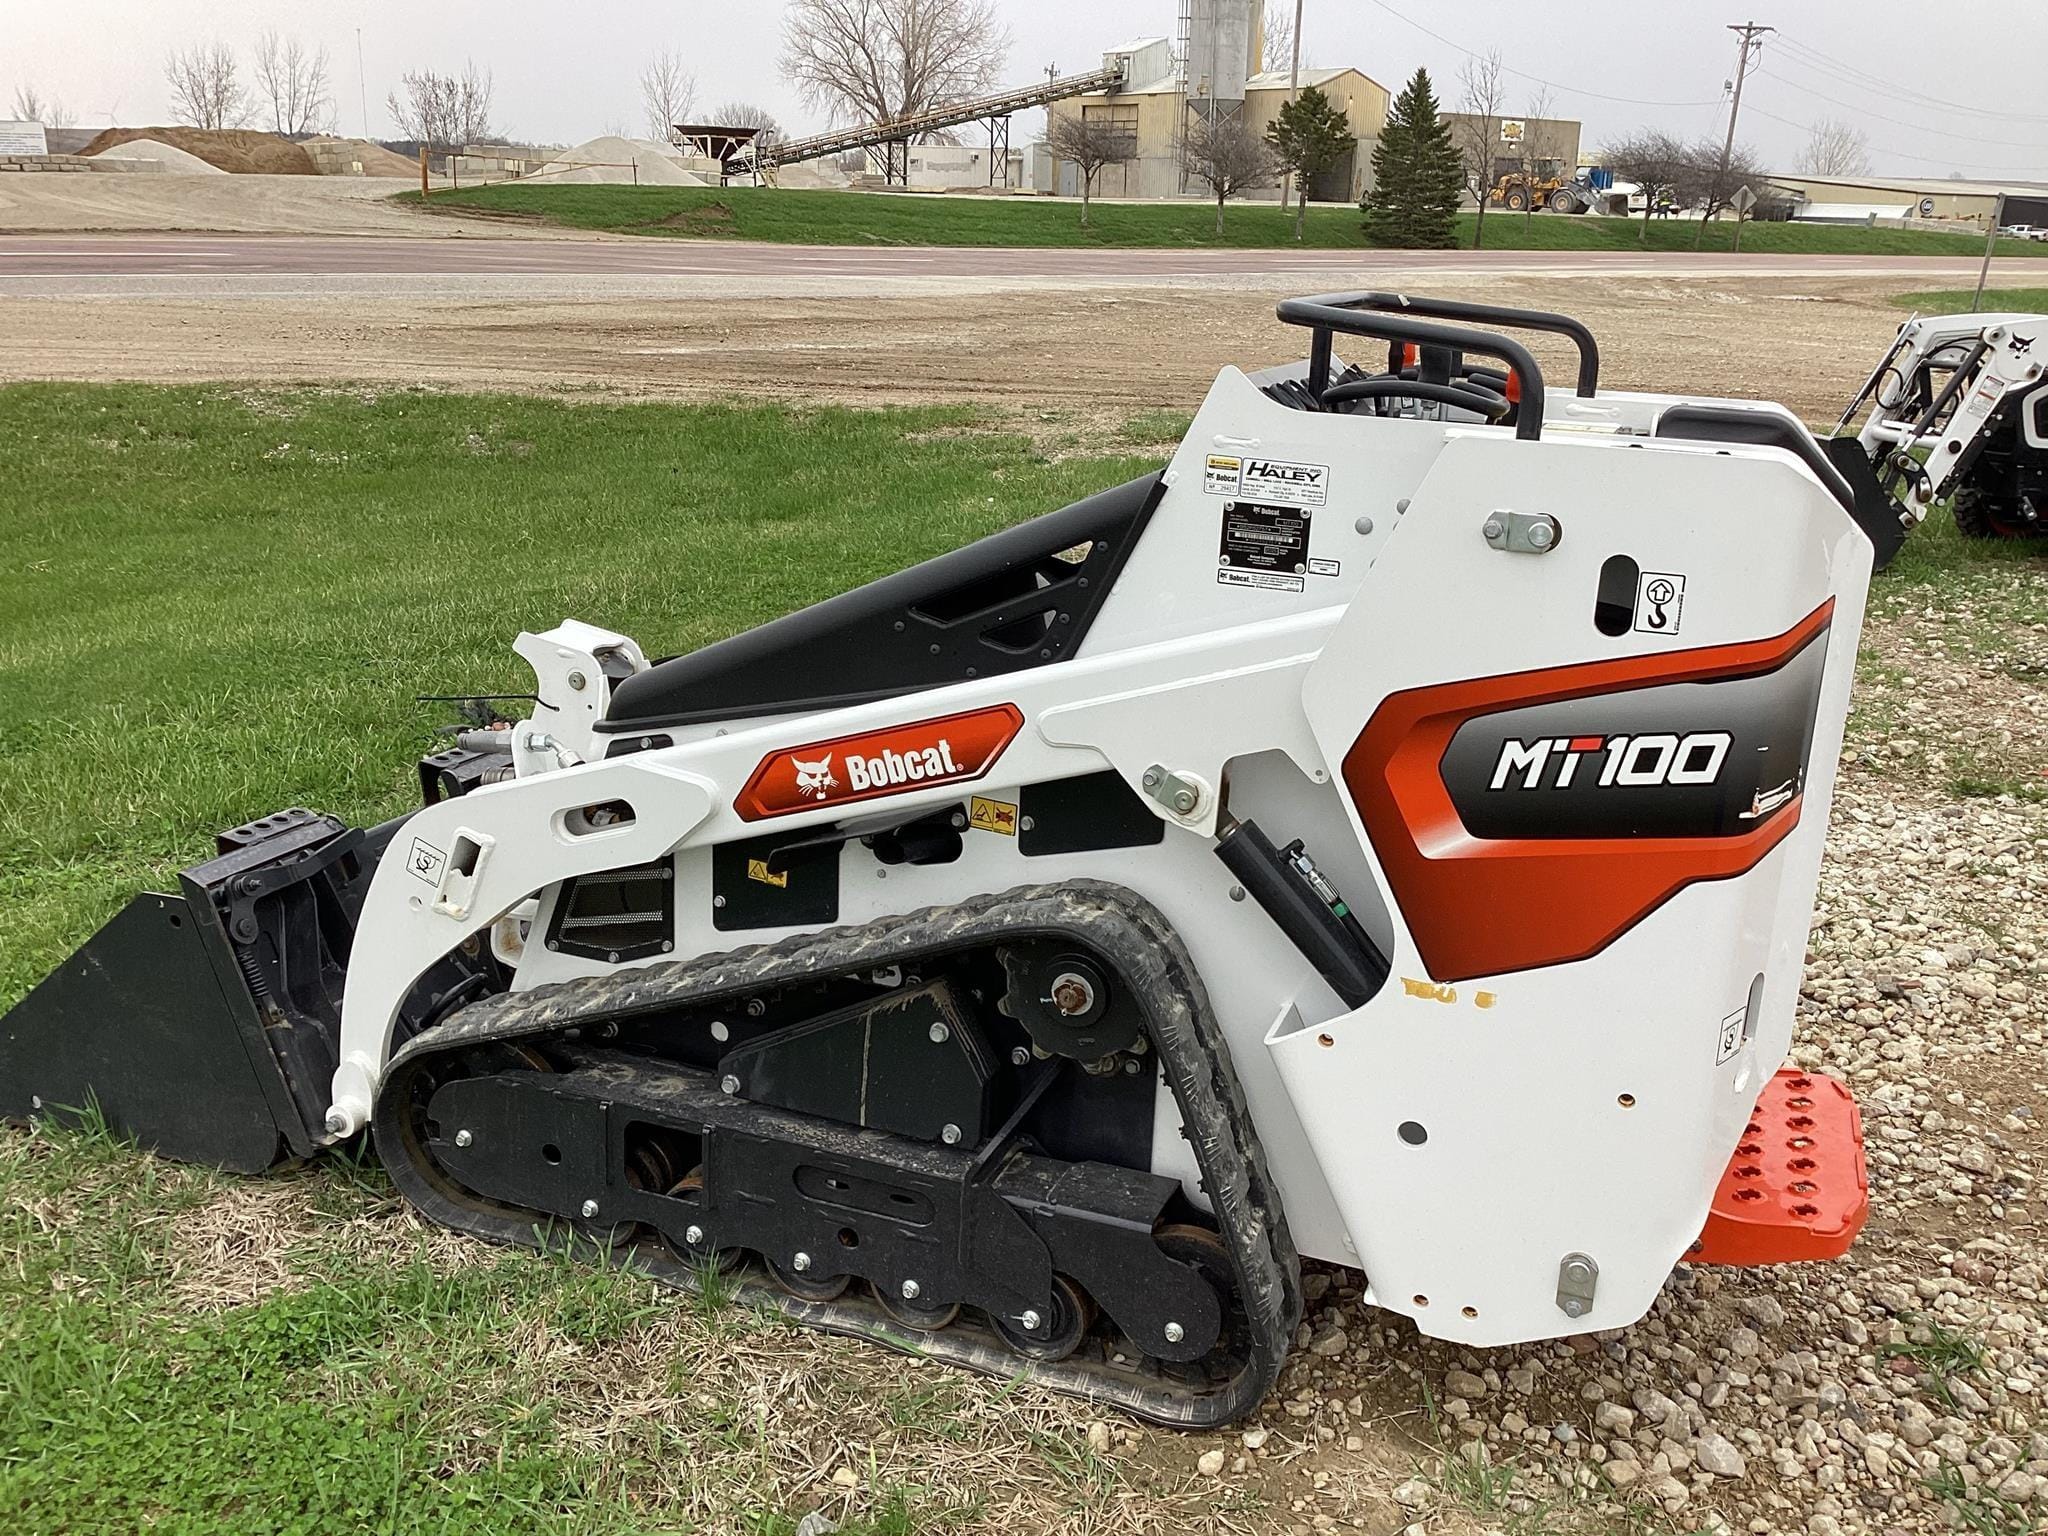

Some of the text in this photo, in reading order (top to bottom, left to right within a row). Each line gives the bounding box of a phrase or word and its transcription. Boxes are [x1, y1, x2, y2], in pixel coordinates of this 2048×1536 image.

[1246, 461, 1323, 483] HALEY
[1270, 464, 1307, 473] EQUIPMENT
[1216, 474, 1238, 483] Bobcat
[1261, 507, 1280, 516] Bobcat
[1229, 573, 1250, 583] Bobcat
[845, 739, 957, 792] Bobcat
[1488, 732, 1733, 790] MT100
